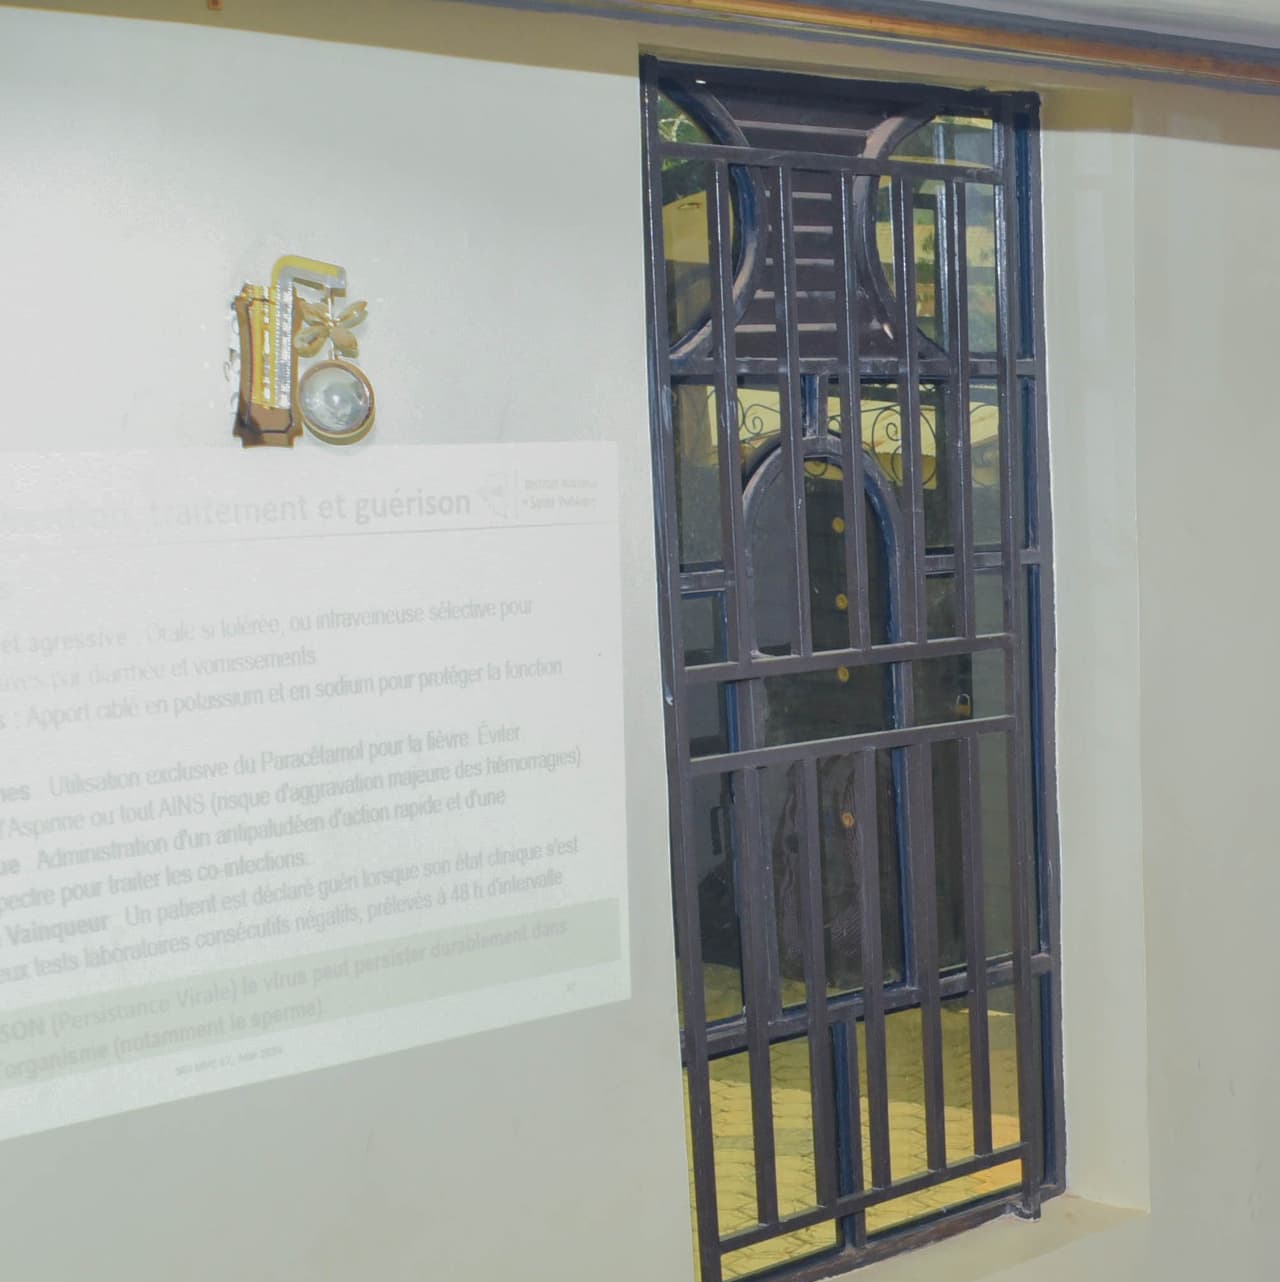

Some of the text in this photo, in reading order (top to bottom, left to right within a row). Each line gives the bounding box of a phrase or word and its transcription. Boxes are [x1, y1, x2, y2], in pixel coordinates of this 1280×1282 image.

[319, 494, 347, 519] et
[355, 488, 471, 525] guérison
[290, 614, 312, 632] ou
[500, 599, 535, 622] pour
[171, 656, 190, 678] et
[193, 645, 317, 677] vomissements
[173, 686, 263, 718] potassium
[269, 682, 285, 703] et
[290, 682, 310, 700] en
[315, 673, 374, 699] sodium
[378, 672, 414, 696] pour
[418, 664, 483, 693] protéger
[487, 661, 501, 681] la
[504, 657, 563, 680] fonction
[144, 760, 229, 786] exclusive
[233, 754, 256, 777] du
[261, 741, 364, 773] Paracétamol
[369, 738, 404, 766] pour
[407, 732, 423, 754] la
[477, 720, 521, 746] Éviter
[90, 809, 115, 828] ou
[119, 802, 154, 826] tout
[158, 792, 206, 819] AINS
[212, 787, 271, 817] (risque
[275, 773, 384, 806] d'aggravation
[388, 764, 451, 793] majeure
[455, 759, 483, 780] des
[36, 788, 506, 871] Administration d'un antipaludéen d'action rapide et d'une
[60, 880, 102, 909] pour
[108, 871, 160, 897] traiter
[166, 864, 193, 887] les
[124, 904, 151, 927] Un
[157, 894, 217, 927] patient
[221, 890, 248, 910] est
[253, 877, 315, 909] déclaré
[318, 871, 359, 902] guéri
[362, 863, 420, 893] lorsque
[422, 858, 451, 878] son
[456, 848, 484, 871] état
[487, 841, 543, 871] clinique
[545, 835, 580, 858] s'est
[34, 867, 564, 977] tests laboratoires consécutifs négatifs, prélevés à 48 h d'intervalle
[52, 918, 568, 1038] (Persistance Virale) le virus peut persister durablement dans
[113, 1017, 225, 1059] (notamment
[229, 1011, 246, 1031] le
